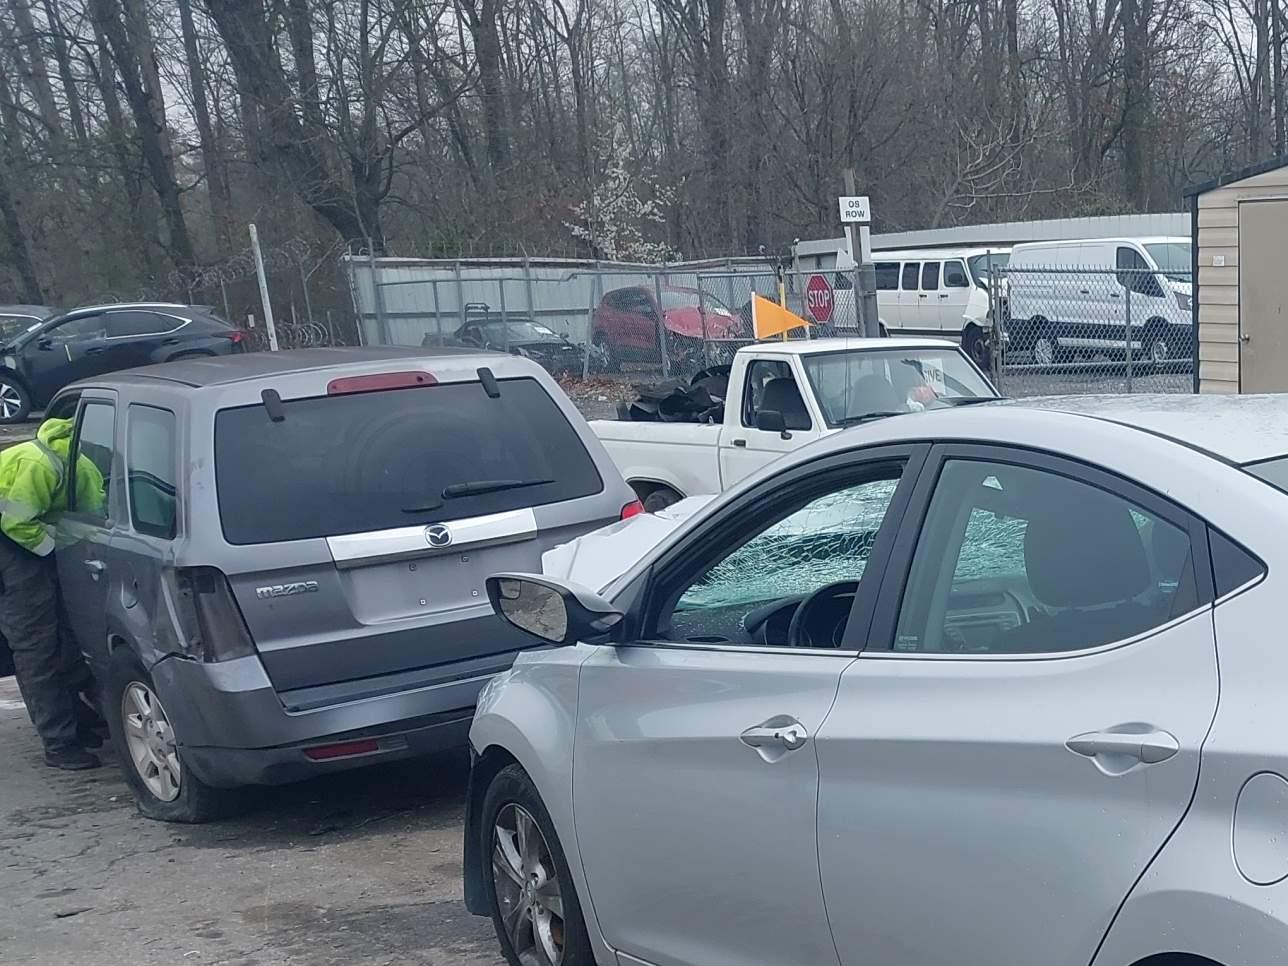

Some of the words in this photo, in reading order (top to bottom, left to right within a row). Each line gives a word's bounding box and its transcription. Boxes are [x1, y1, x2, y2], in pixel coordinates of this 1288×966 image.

[848, 200, 860, 208] OS
[845, 210, 865, 218] ROW
[808, 290, 829, 308] STOP
